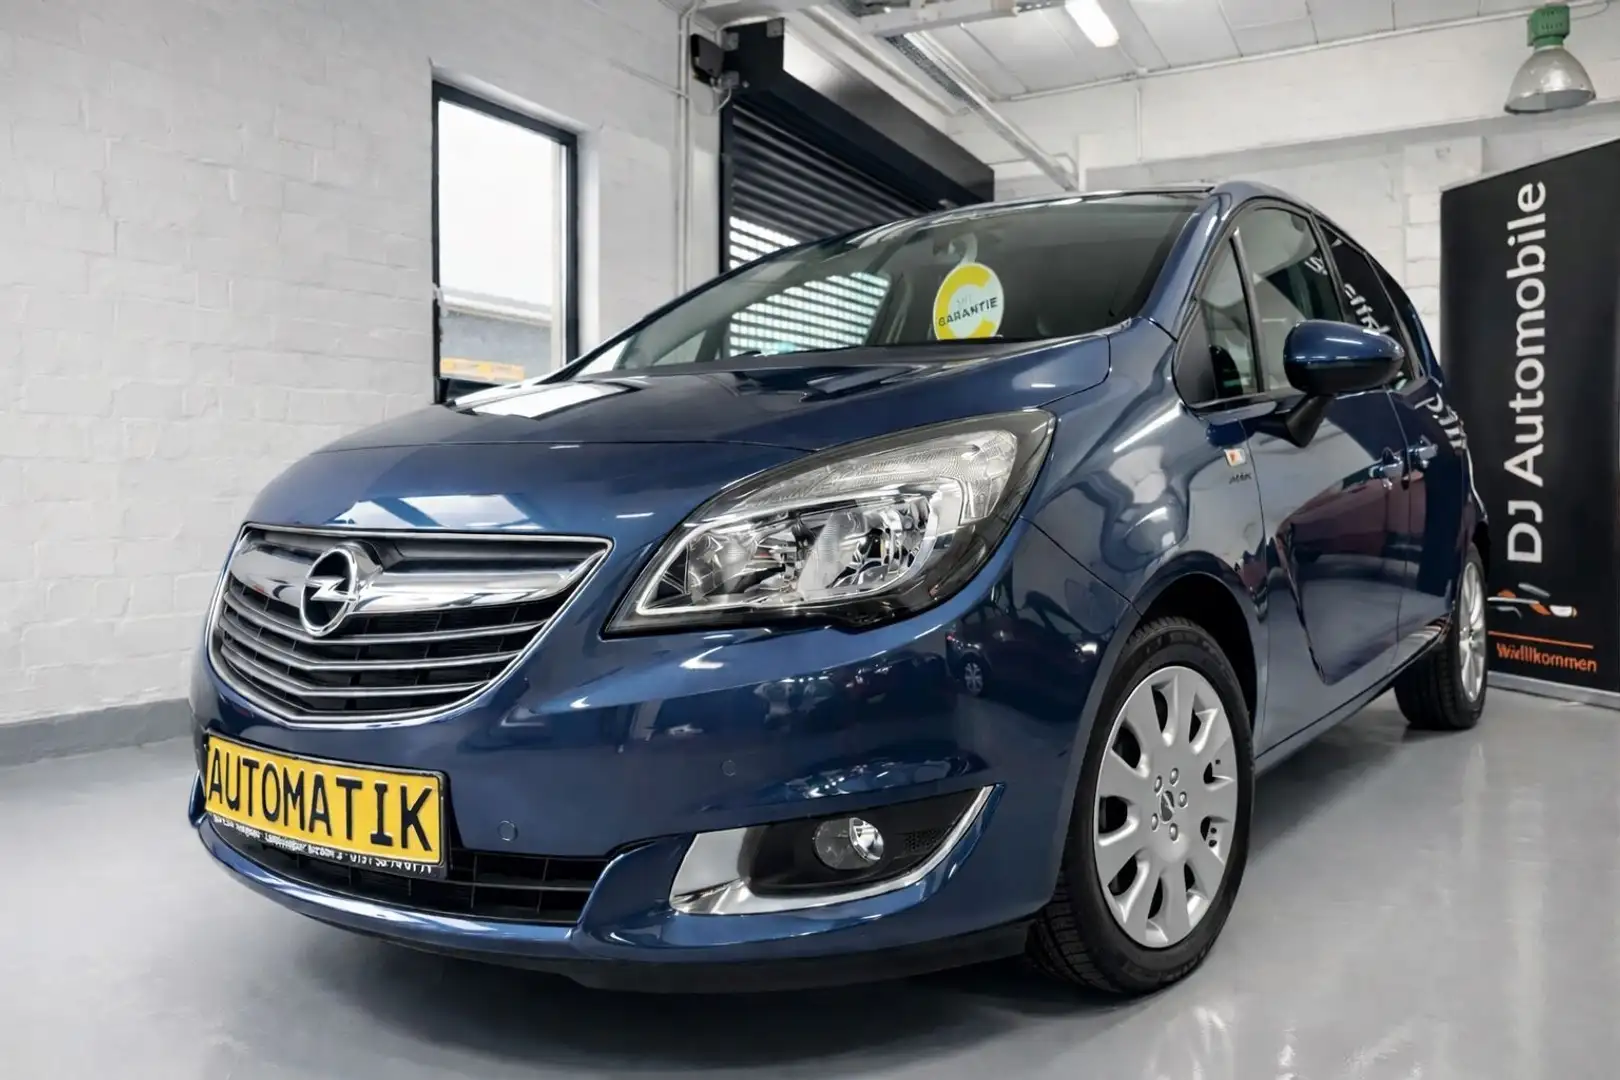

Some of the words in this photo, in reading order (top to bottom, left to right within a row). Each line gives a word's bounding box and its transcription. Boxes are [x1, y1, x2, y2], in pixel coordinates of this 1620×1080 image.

[938, 296, 998, 327] GARANTIE
[1504, 181, 1546, 487] Automobile
[1507, 500, 1543, 563] DJ
[208, 747, 433, 852] AUTOMATIK
